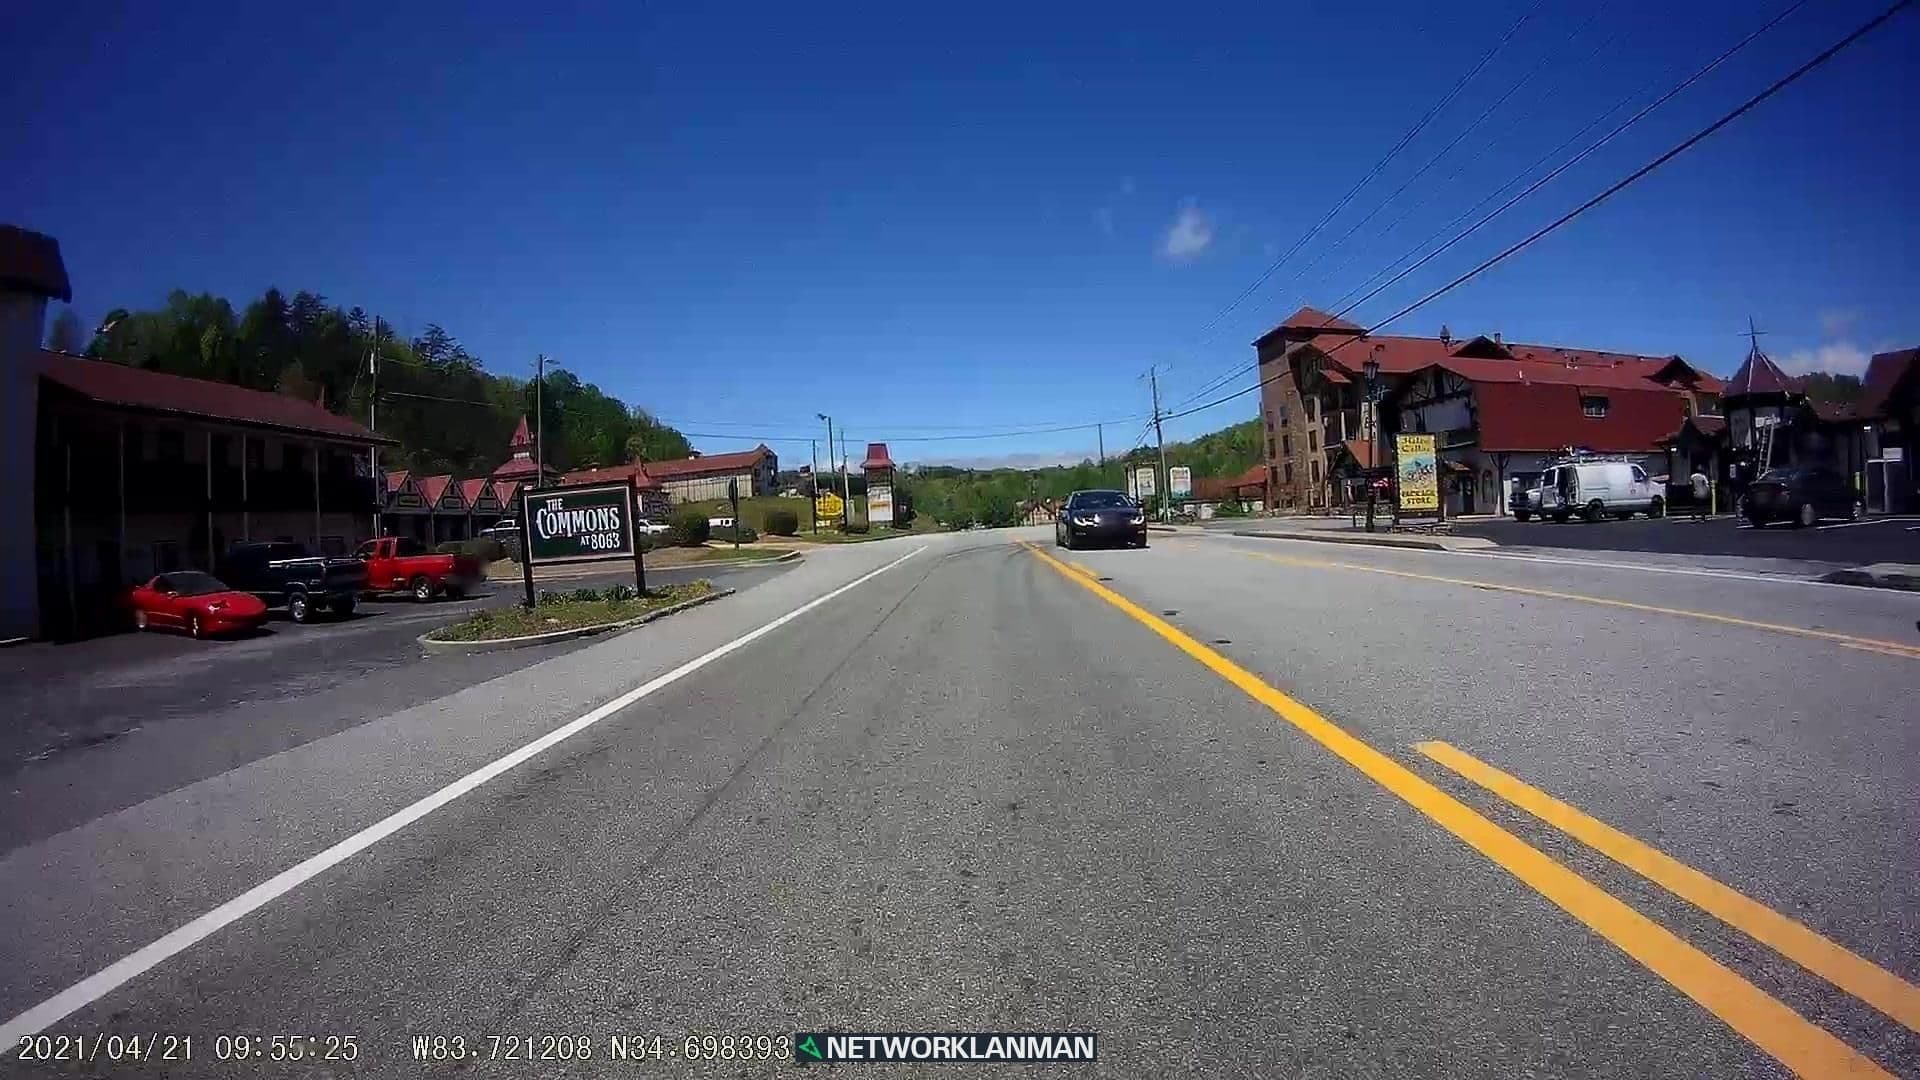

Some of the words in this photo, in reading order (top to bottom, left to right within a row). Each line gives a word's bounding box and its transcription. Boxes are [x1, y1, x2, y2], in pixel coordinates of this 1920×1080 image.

[546, 498, 563, 511] THE
[536, 507, 620, 539] COMMONS
[580, 536, 590, 546] AT
[591, 532, 620, 550] 8063
